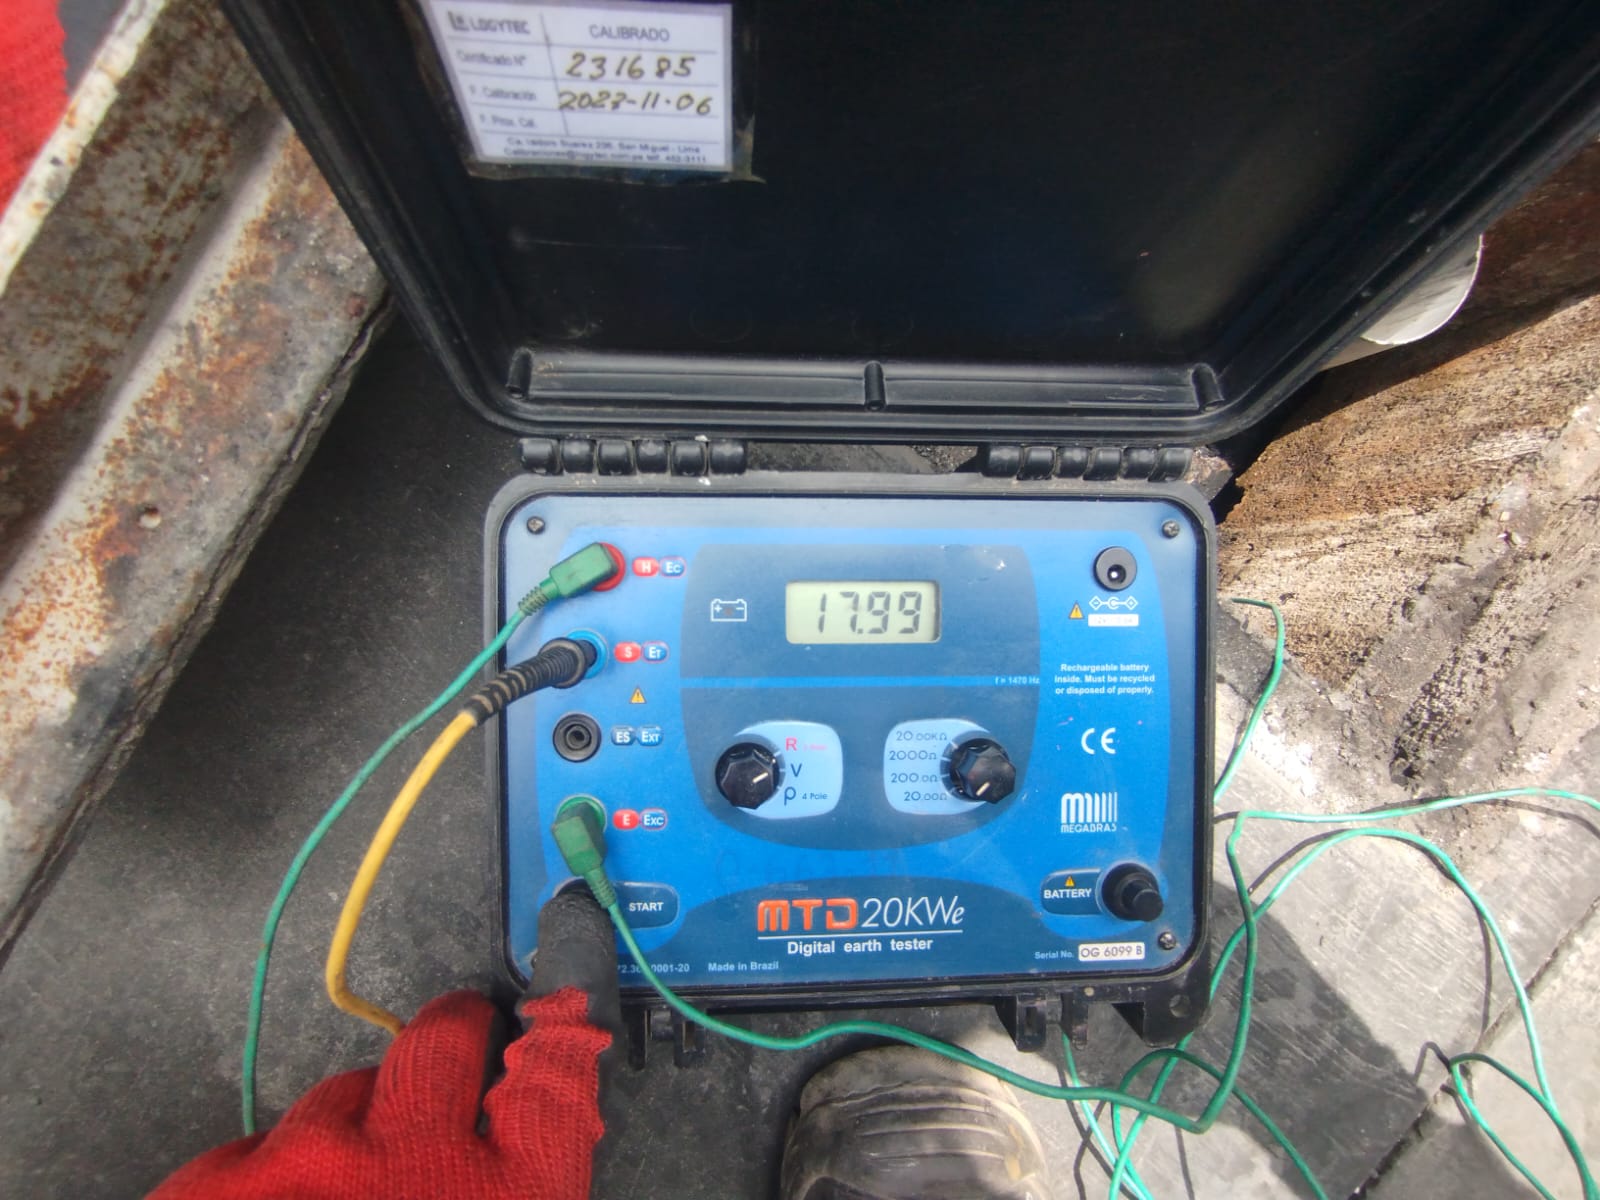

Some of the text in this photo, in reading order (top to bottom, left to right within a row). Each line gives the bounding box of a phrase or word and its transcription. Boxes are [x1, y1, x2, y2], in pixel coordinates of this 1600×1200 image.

[589, 24, 670, 42] CALIBRADO
[641, 562, 651, 573] H
[818, 591, 922, 634] 17.99
[624, 646, 633, 658] S
[1061, 664, 1149, 673] Rechargeable battery
[1084, 675, 1105, 683] Must
[1120, 674, 1155, 684] recycled
[1066, 686, 1105, 695] disposed
[616, 731, 630, 743] ES
[1081, 728, 1116, 755] CE
[785, 737, 797, 751] R
[623, 814, 631, 826] E
[1043, 889, 1092, 899] BATTERY
[628, 902, 664, 912] START
[757, 897, 858, 932] MTD
[787, 938, 934, 957] Digital earth tester
[1104, 945, 1133, 957] 6099
[1034, 950, 1075, 960] Serial No.
[708, 961, 779, 972] Made in Brazil
